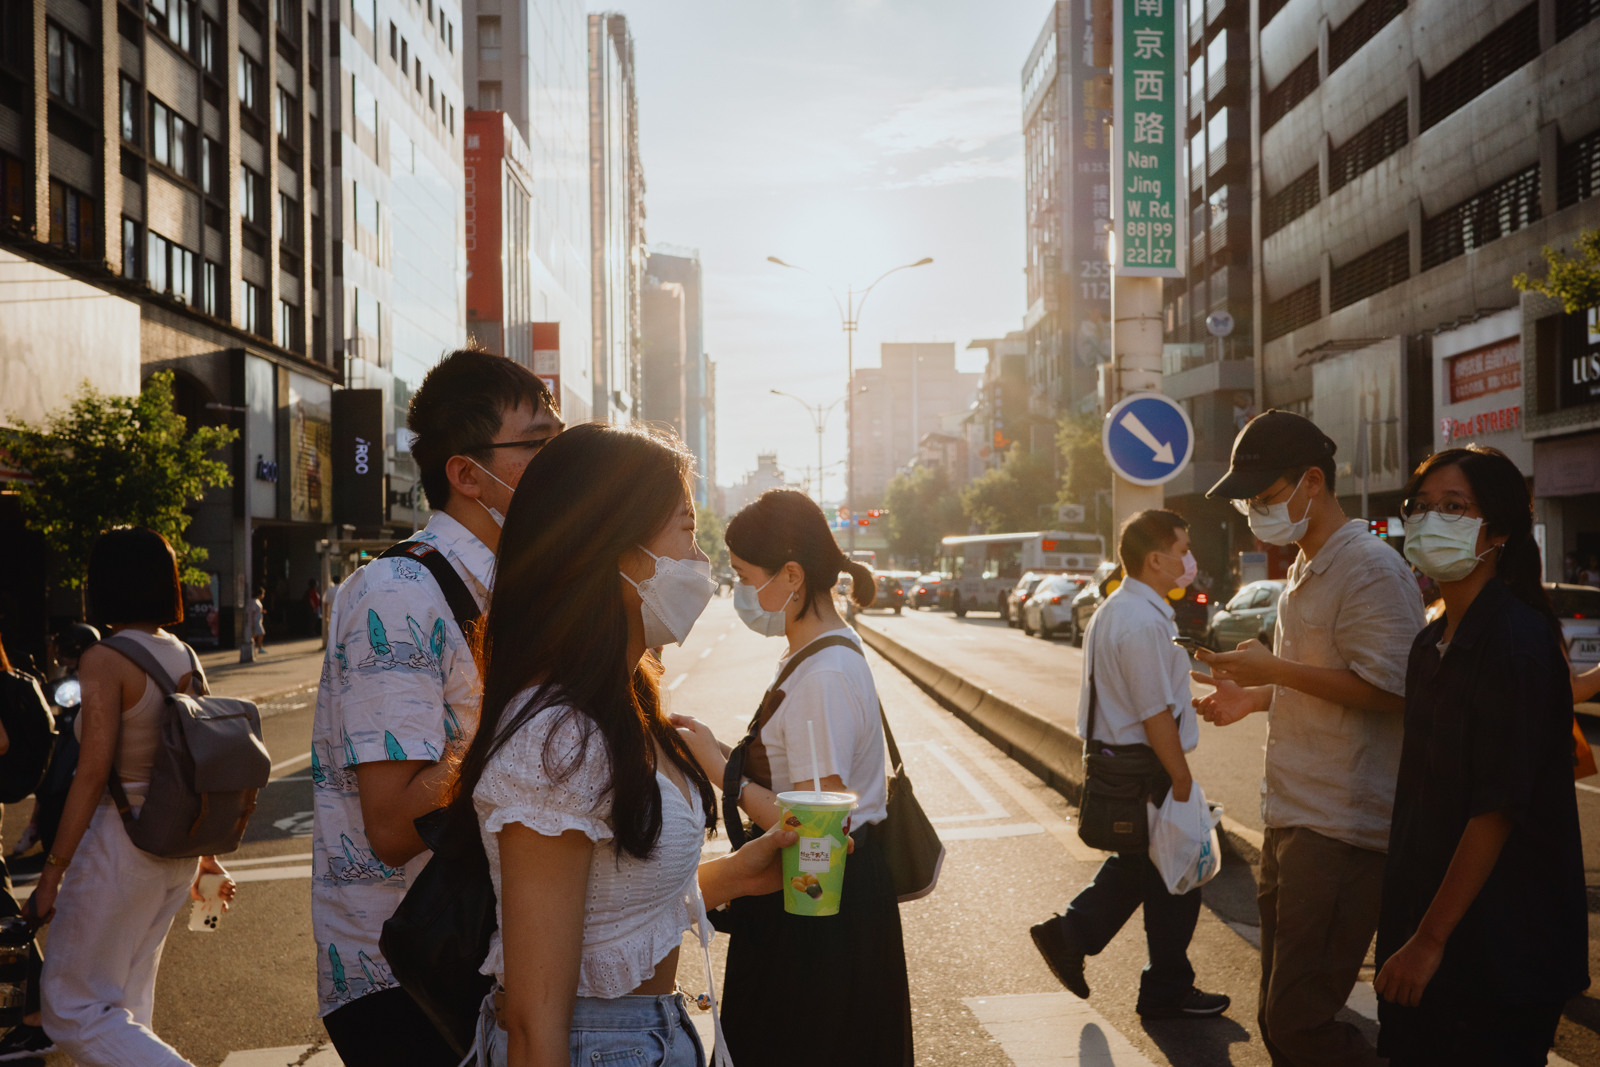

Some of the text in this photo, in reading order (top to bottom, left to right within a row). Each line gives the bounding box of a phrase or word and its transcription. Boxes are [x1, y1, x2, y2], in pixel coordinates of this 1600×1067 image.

[1133, 0, 1165, 144] 南京西路
[1127, 150, 1158, 169] Nan
[1127, 175, 1161, 199] Jing
[1127, 200, 1174, 218] W. Rd.
[1126, 221, 1173, 238] 88 99
[1126, 247, 1172, 264] 22 27
[1452, 406, 1520, 438] 2nd STREET
